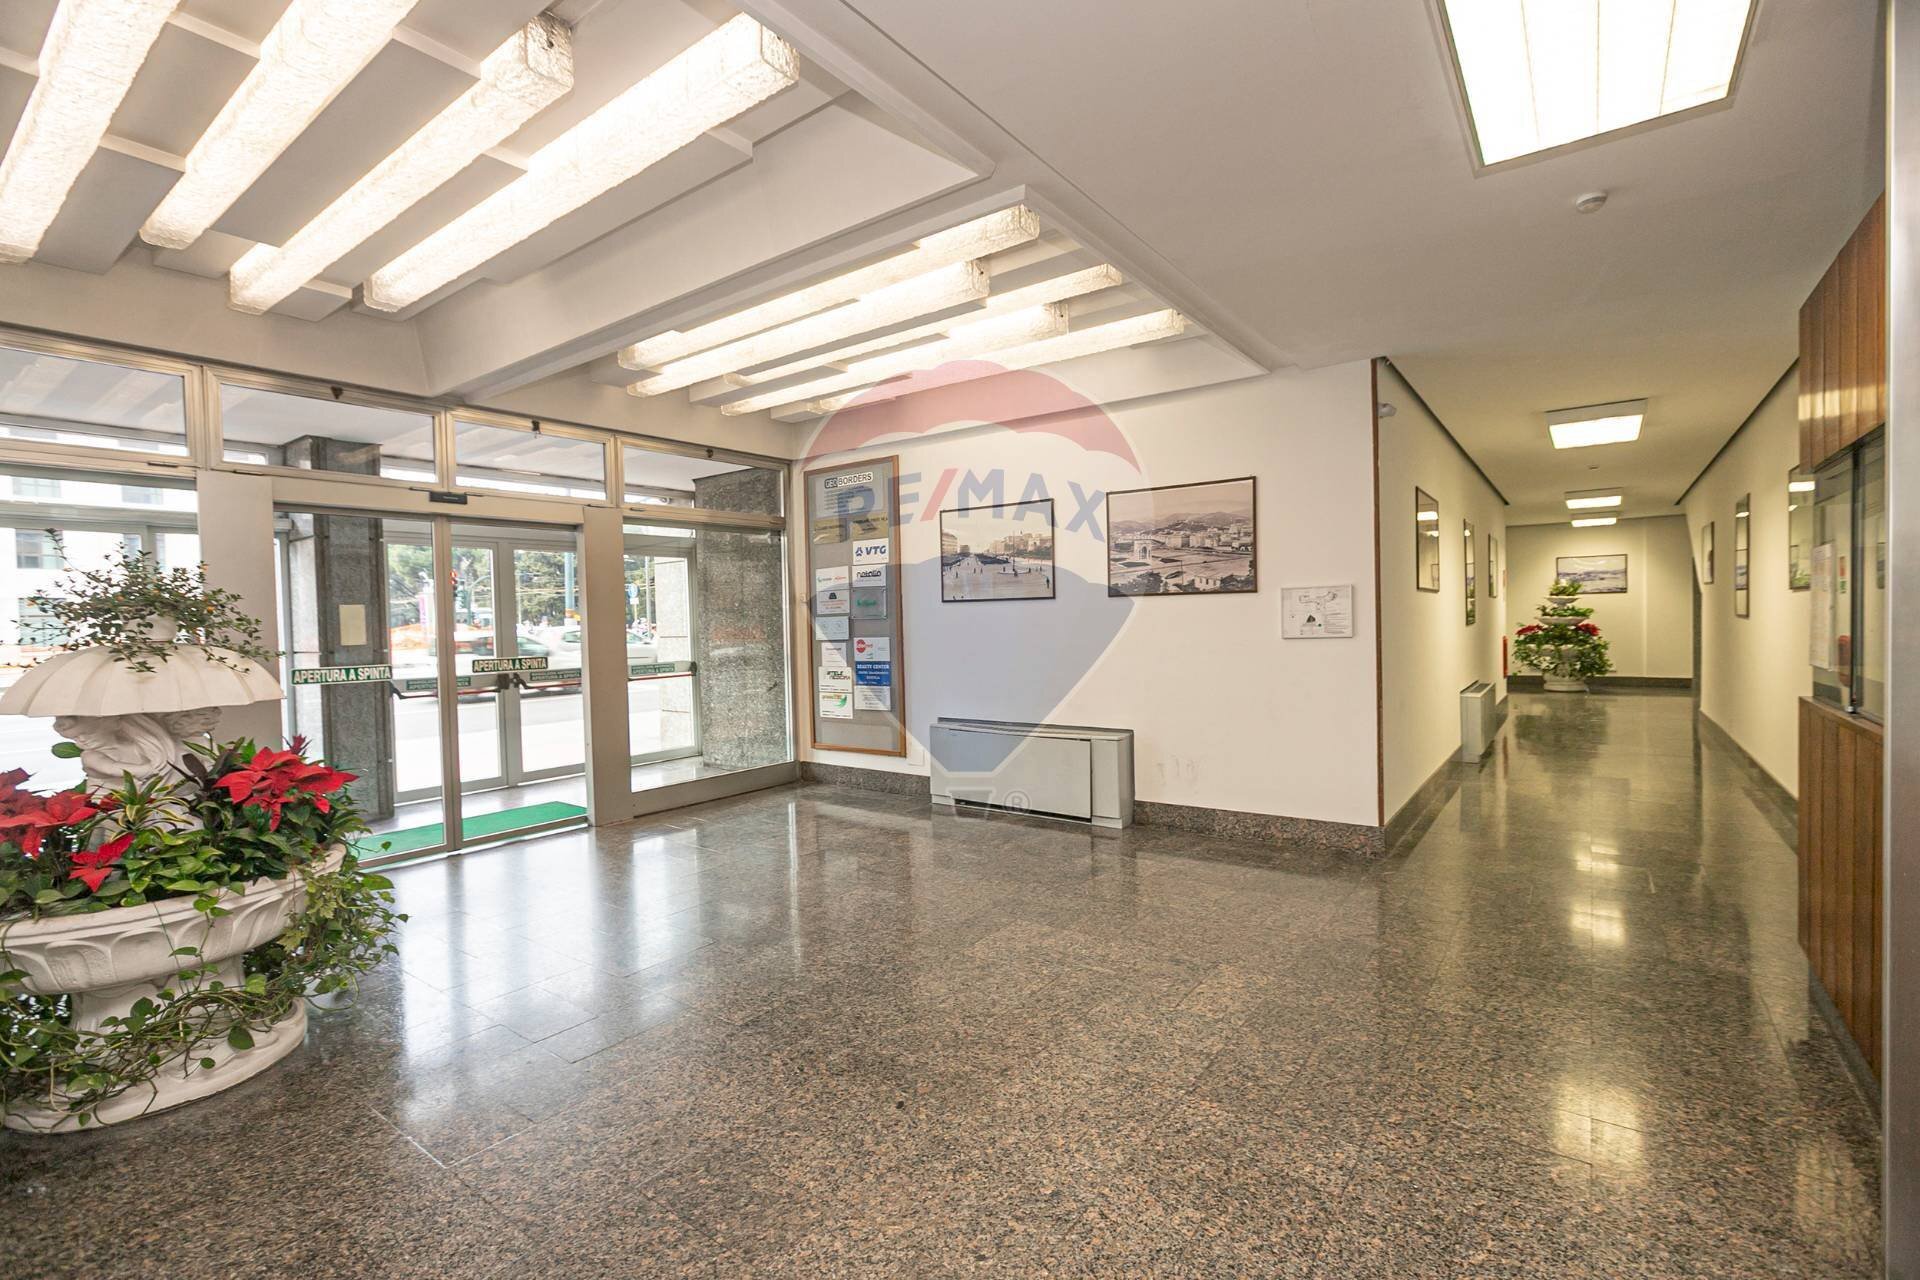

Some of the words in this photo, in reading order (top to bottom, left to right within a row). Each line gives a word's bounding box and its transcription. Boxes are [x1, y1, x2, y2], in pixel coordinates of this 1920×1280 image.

[838, 473, 872, 486] BORDERS
[865, 545, 887, 555] VTG
[474, 660, 514, 672] APERTURA
[514, 659, 520, 670] A
[521, 658, 546, 669] SPINTA
[294, 669, 347, 684] APERTURA
[348, 668, 356, 681] A
[358, 666, 391, 680] SPINTA
